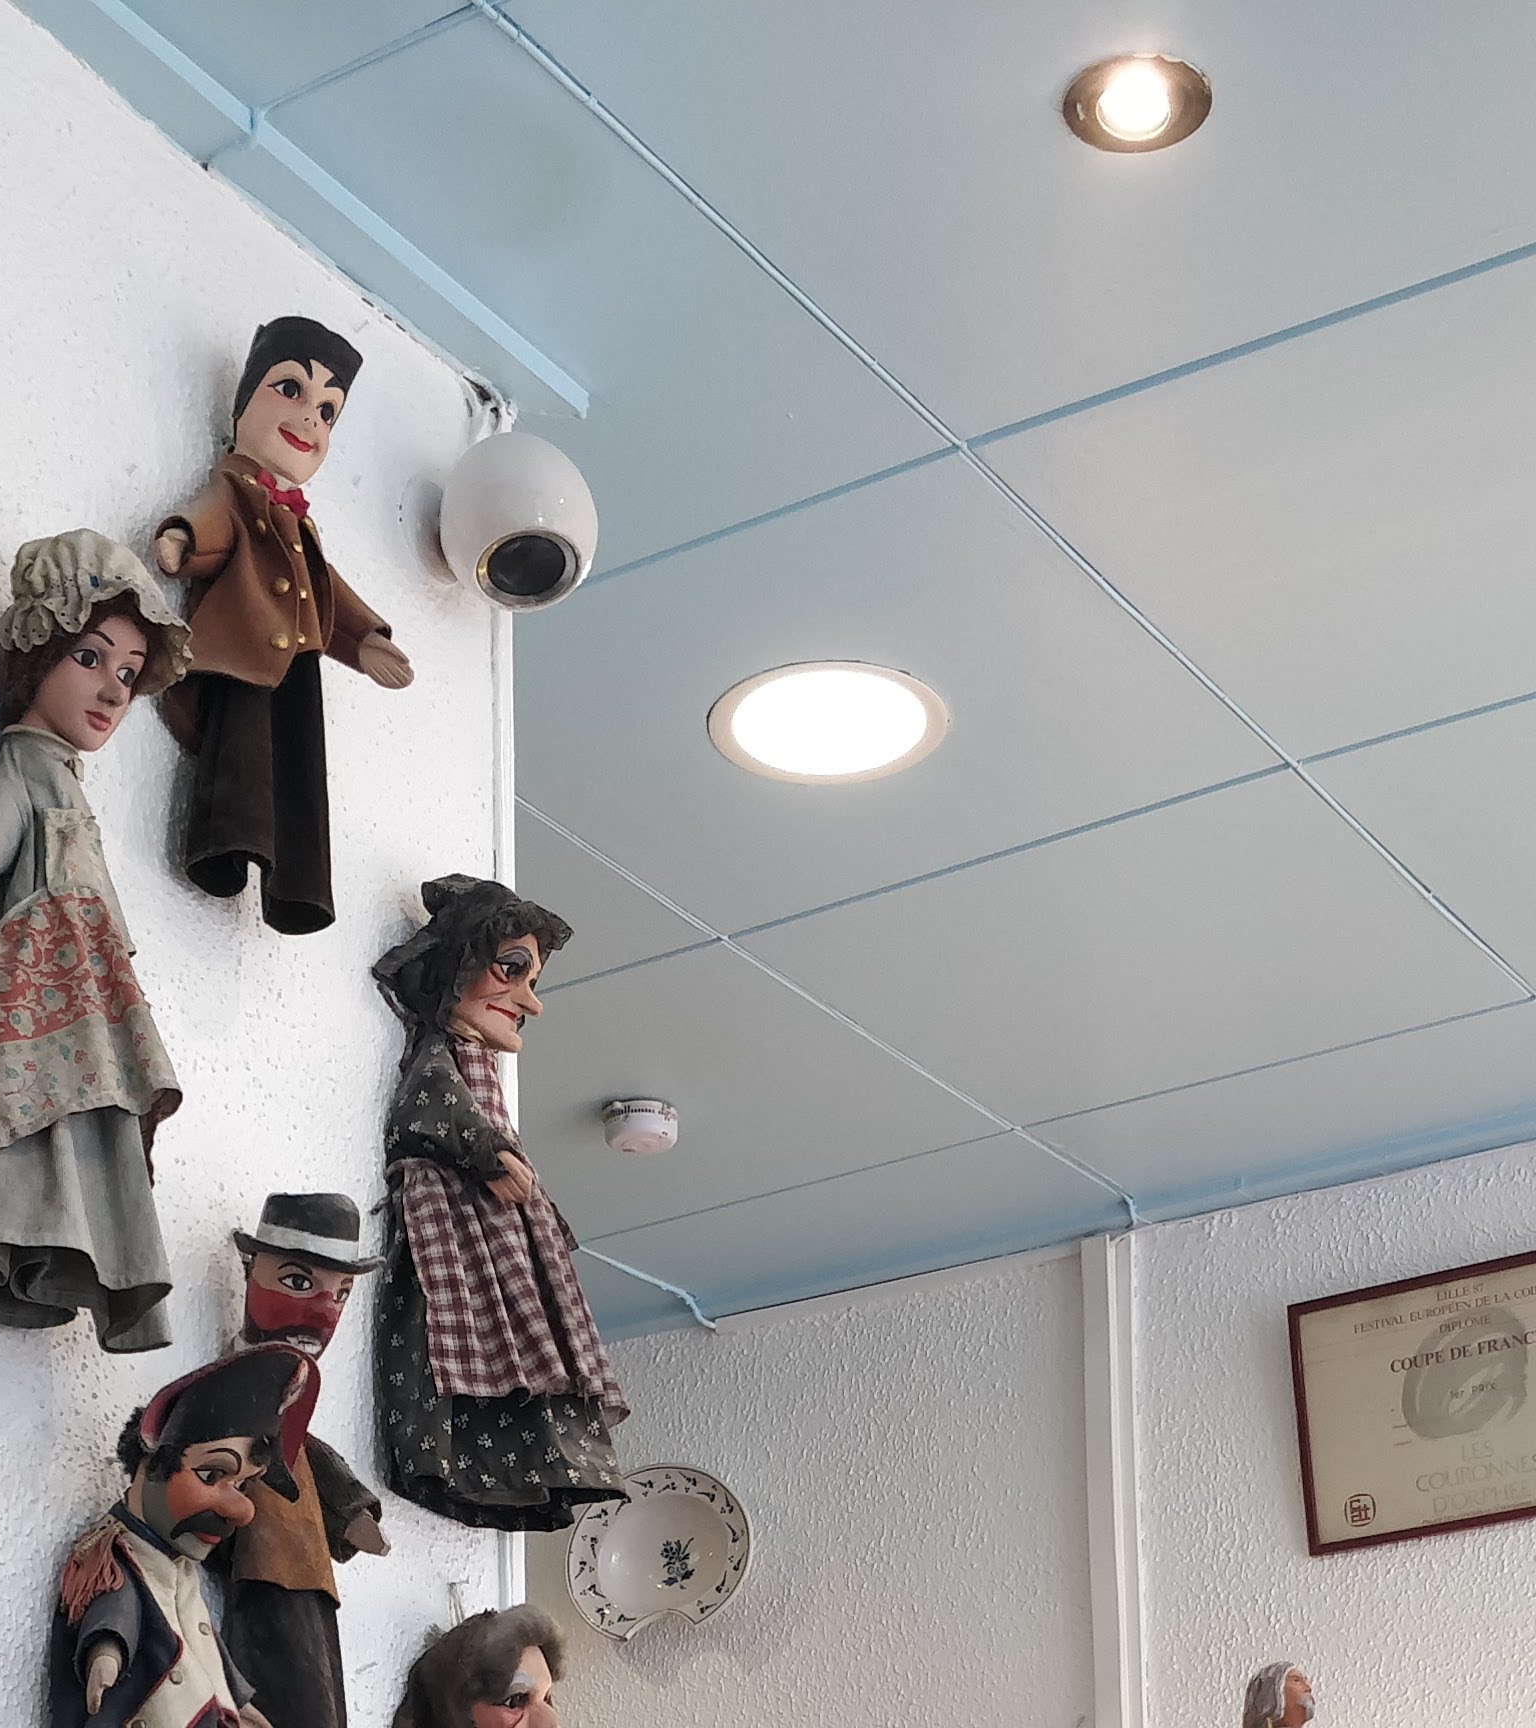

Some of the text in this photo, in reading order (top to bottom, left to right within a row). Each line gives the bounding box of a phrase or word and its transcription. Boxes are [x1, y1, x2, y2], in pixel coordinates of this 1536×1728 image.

[1436, 1286, 1469, 1301] LILLE
[1353, 1314, 1404, 1334] FESTIVAL
[1409, 1300, 1471, 1322] EUROPÉEN
[1474, 1295, 1491, 1308] DE
[1494, 1292, 1511, 1304] LA
[1439, 1313, 1492, 1334] DIPLÔME
[1389, 1349, 1446, 1374] COUPE
[1449, 1345, 1475, 1362] DE
